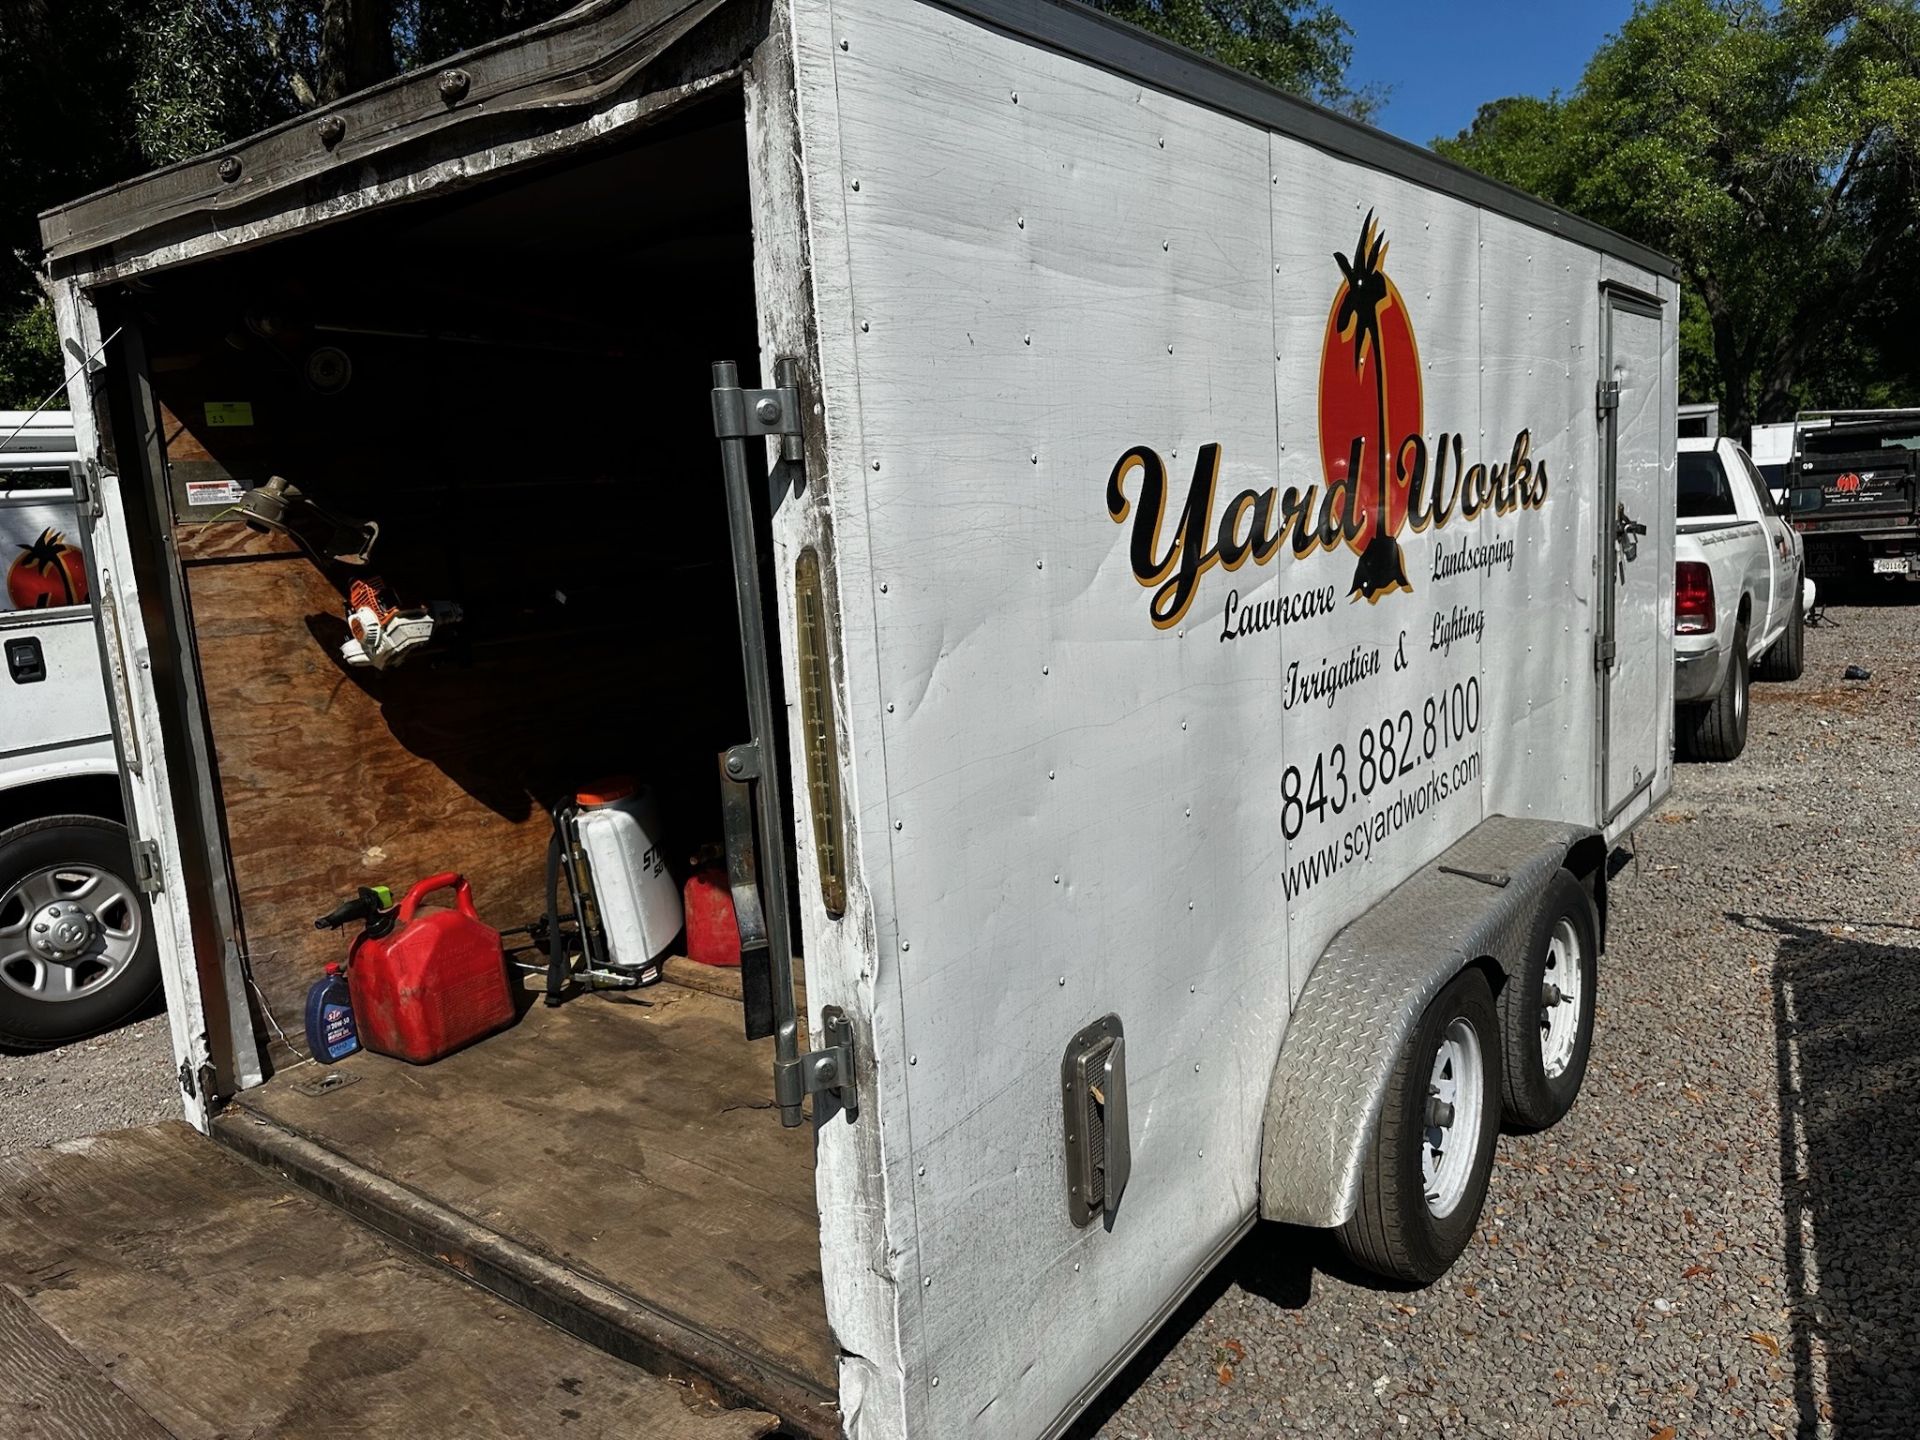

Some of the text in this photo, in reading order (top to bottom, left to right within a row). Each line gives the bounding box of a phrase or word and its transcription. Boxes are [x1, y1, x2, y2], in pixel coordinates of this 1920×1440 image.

[1106, 427, 1549, 631] Yard Works
[1432, 534, 1515, 582] Landscaping
[1220, 583, 1336, 643] Lawncare
[1282, 606, 1486, 711] Irrigation & Lighting
[1280, 676, 1481, 841] 843.882.8100
[1281, 749, 1482, 902] www.scyardworks.com
